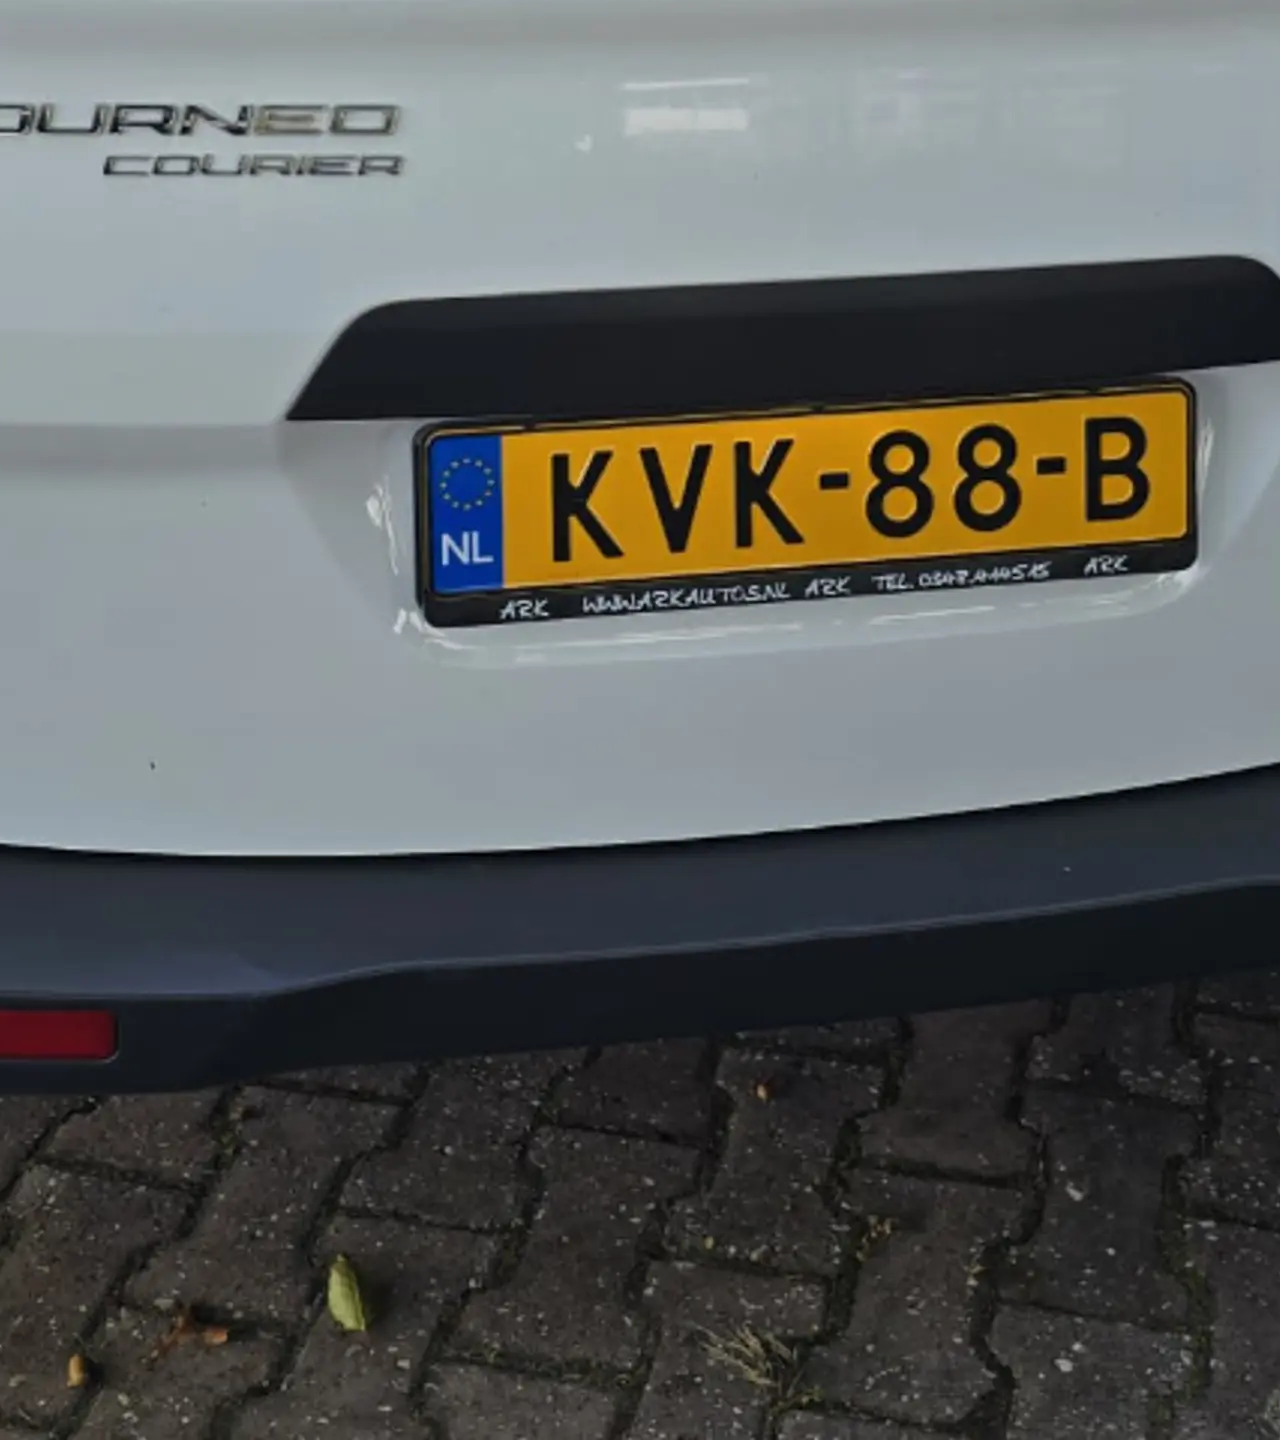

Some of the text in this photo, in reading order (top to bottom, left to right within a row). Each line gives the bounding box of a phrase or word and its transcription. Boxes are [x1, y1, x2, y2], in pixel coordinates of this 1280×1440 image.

[102, 154, 405, 176] COURIER
[550, 417, 1150, 562] KVK-88-B
[440, 531, 494, 566] NL
